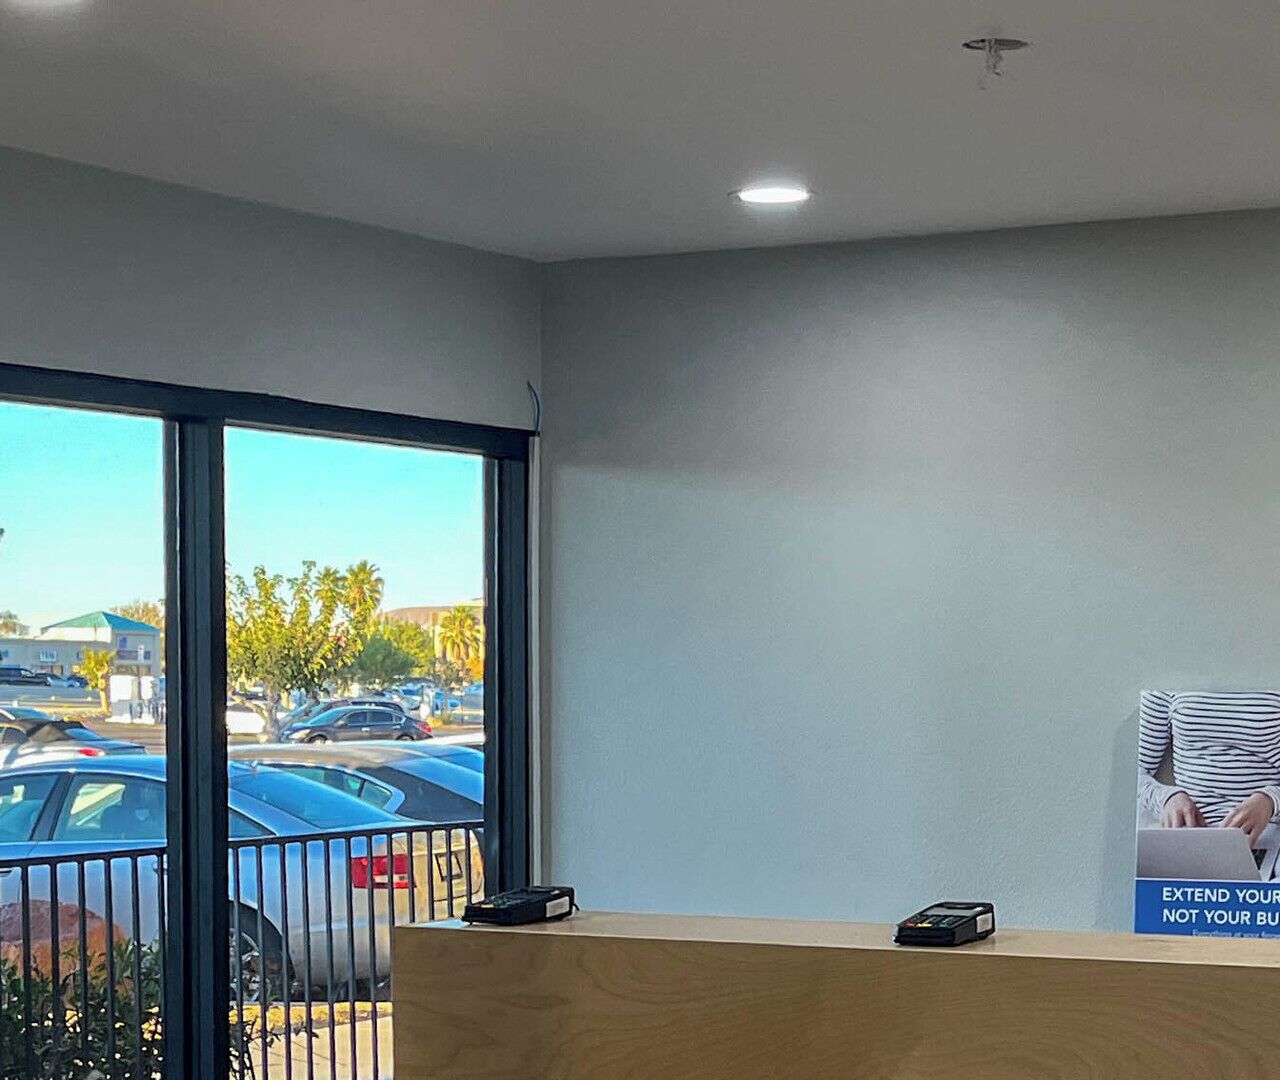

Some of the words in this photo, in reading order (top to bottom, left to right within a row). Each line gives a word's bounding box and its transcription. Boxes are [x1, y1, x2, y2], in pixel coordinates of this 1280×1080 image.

[1162, 886, 1230, 904] EXTEND
[1162, 909, 1199, 924] NOT
[1204, 910, 1251, 926] YOUR
